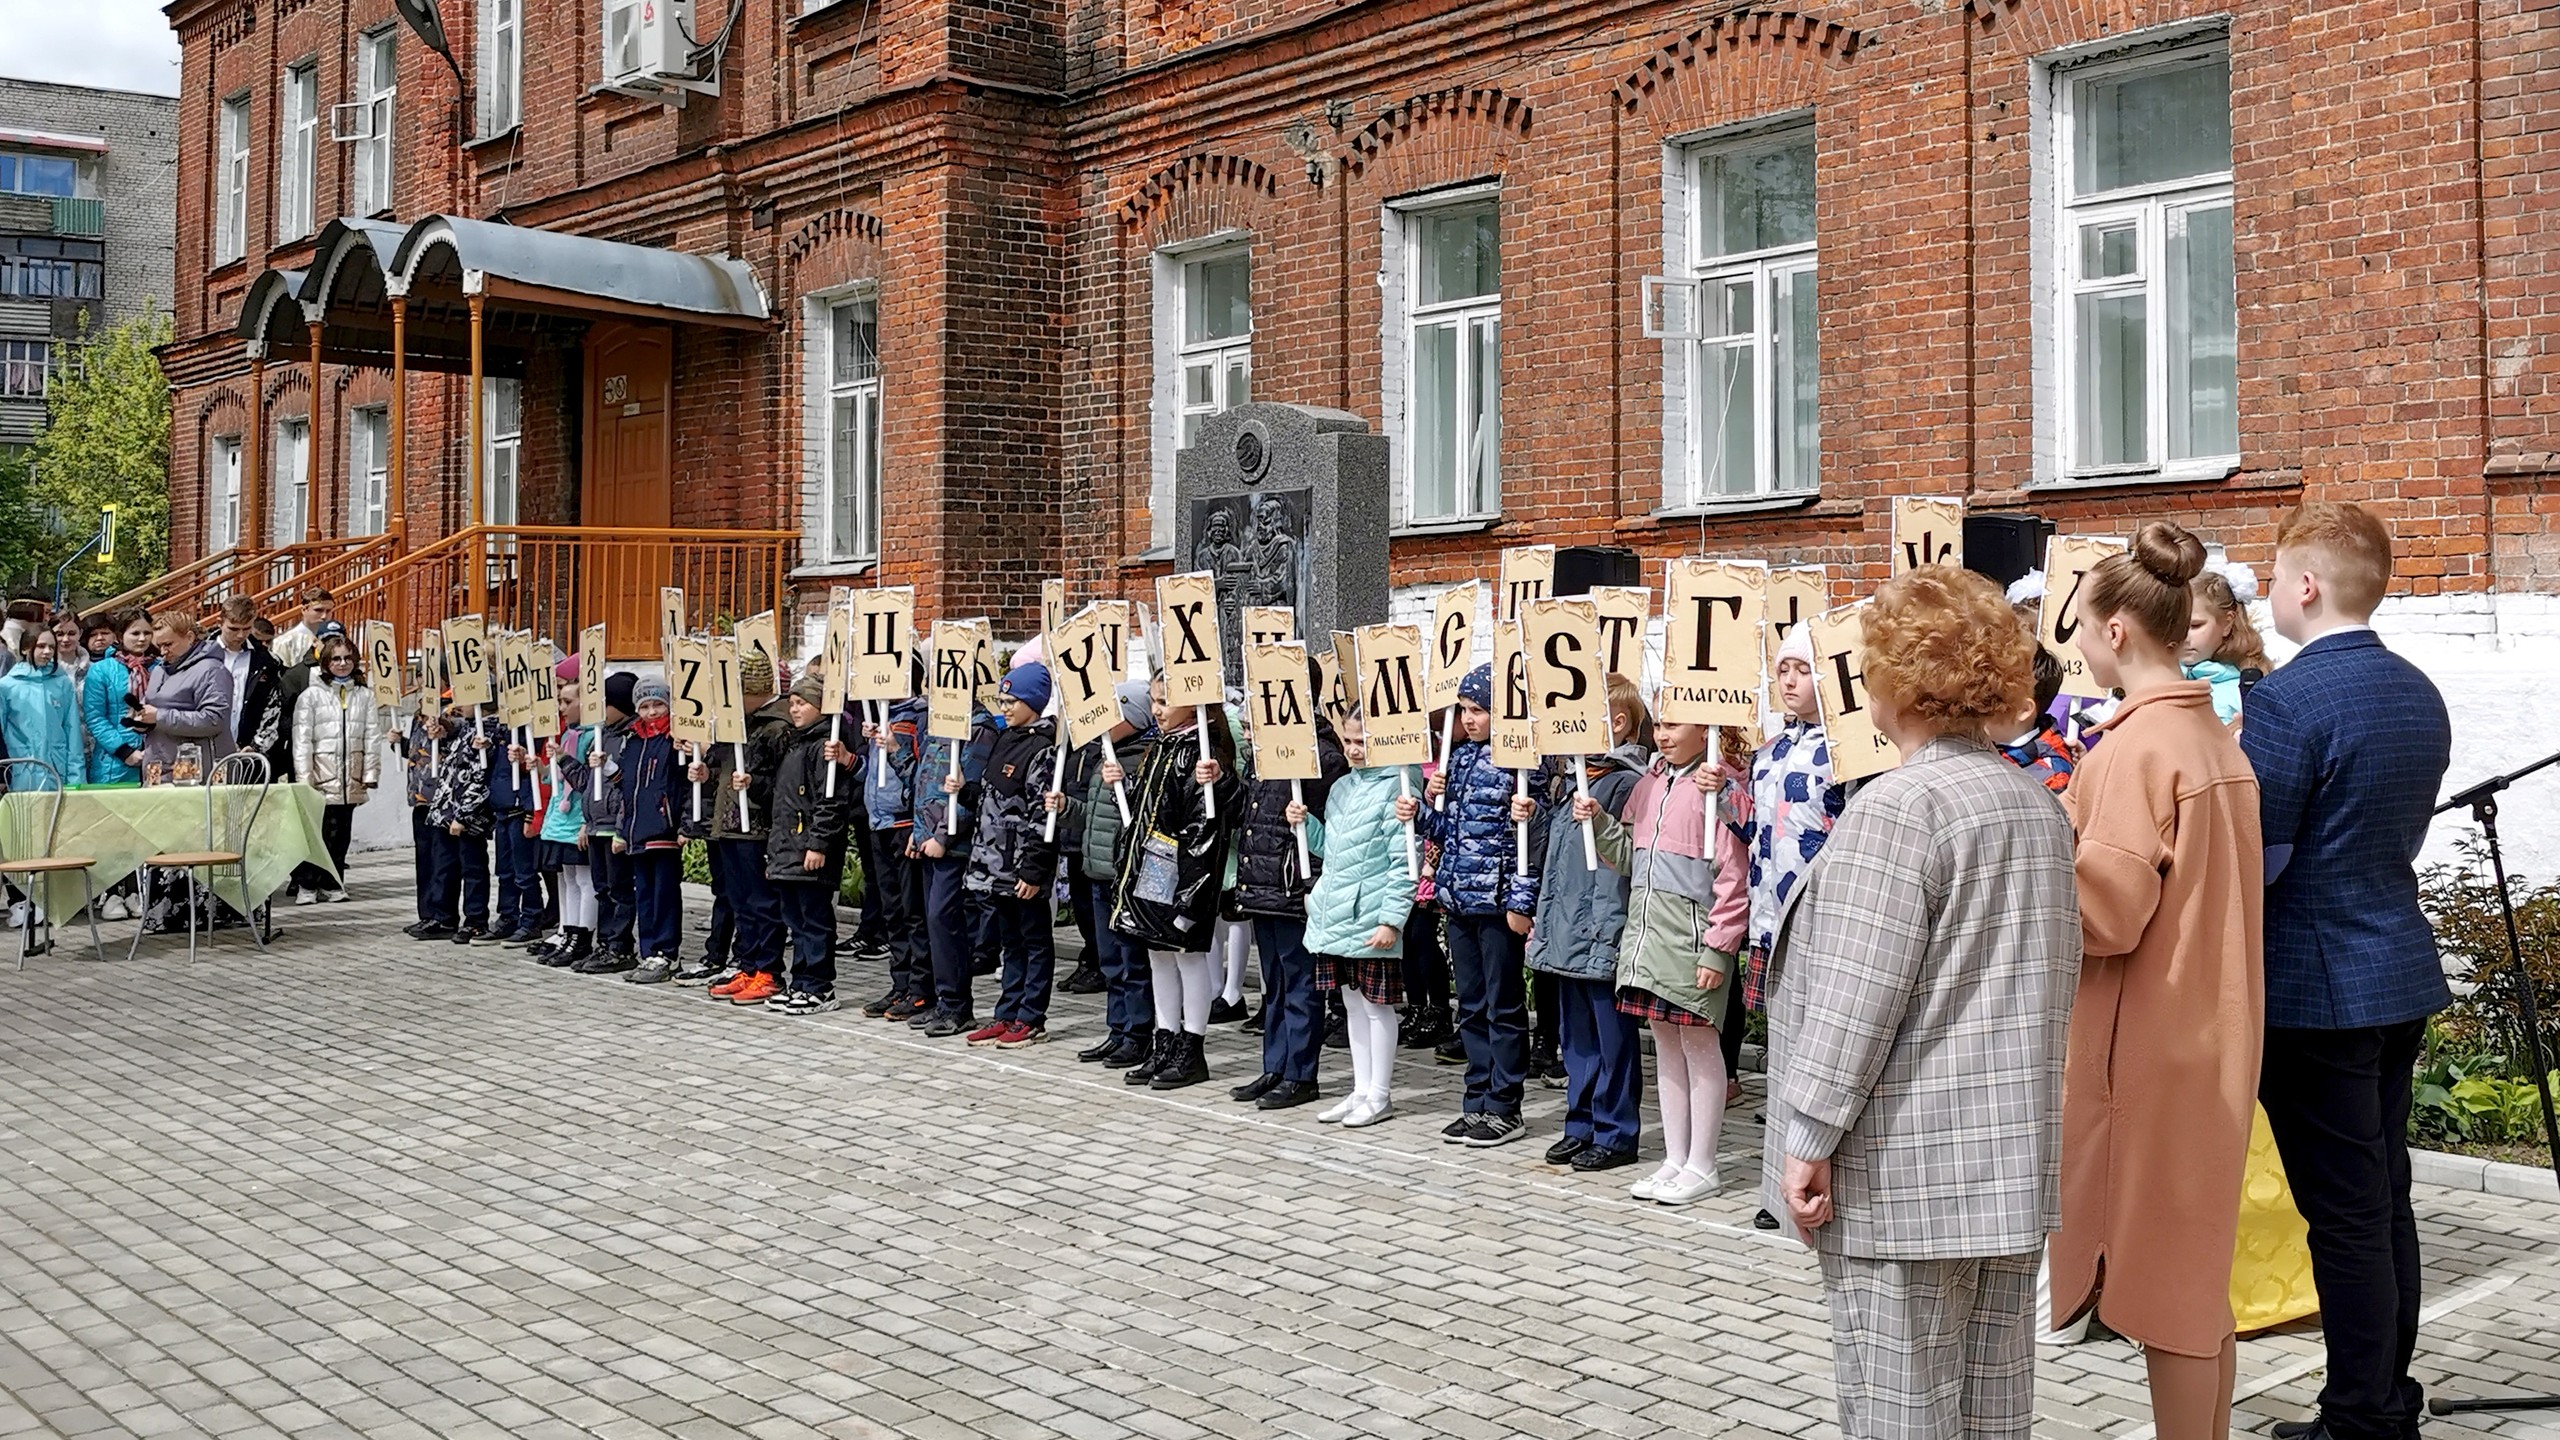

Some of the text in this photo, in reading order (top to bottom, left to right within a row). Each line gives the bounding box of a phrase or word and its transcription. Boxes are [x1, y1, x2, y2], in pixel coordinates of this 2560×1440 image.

[863, 611, 902, 668] Ц
[1687, 596, 1743, 671] Г
[1370, 655, 1422, 717] М
